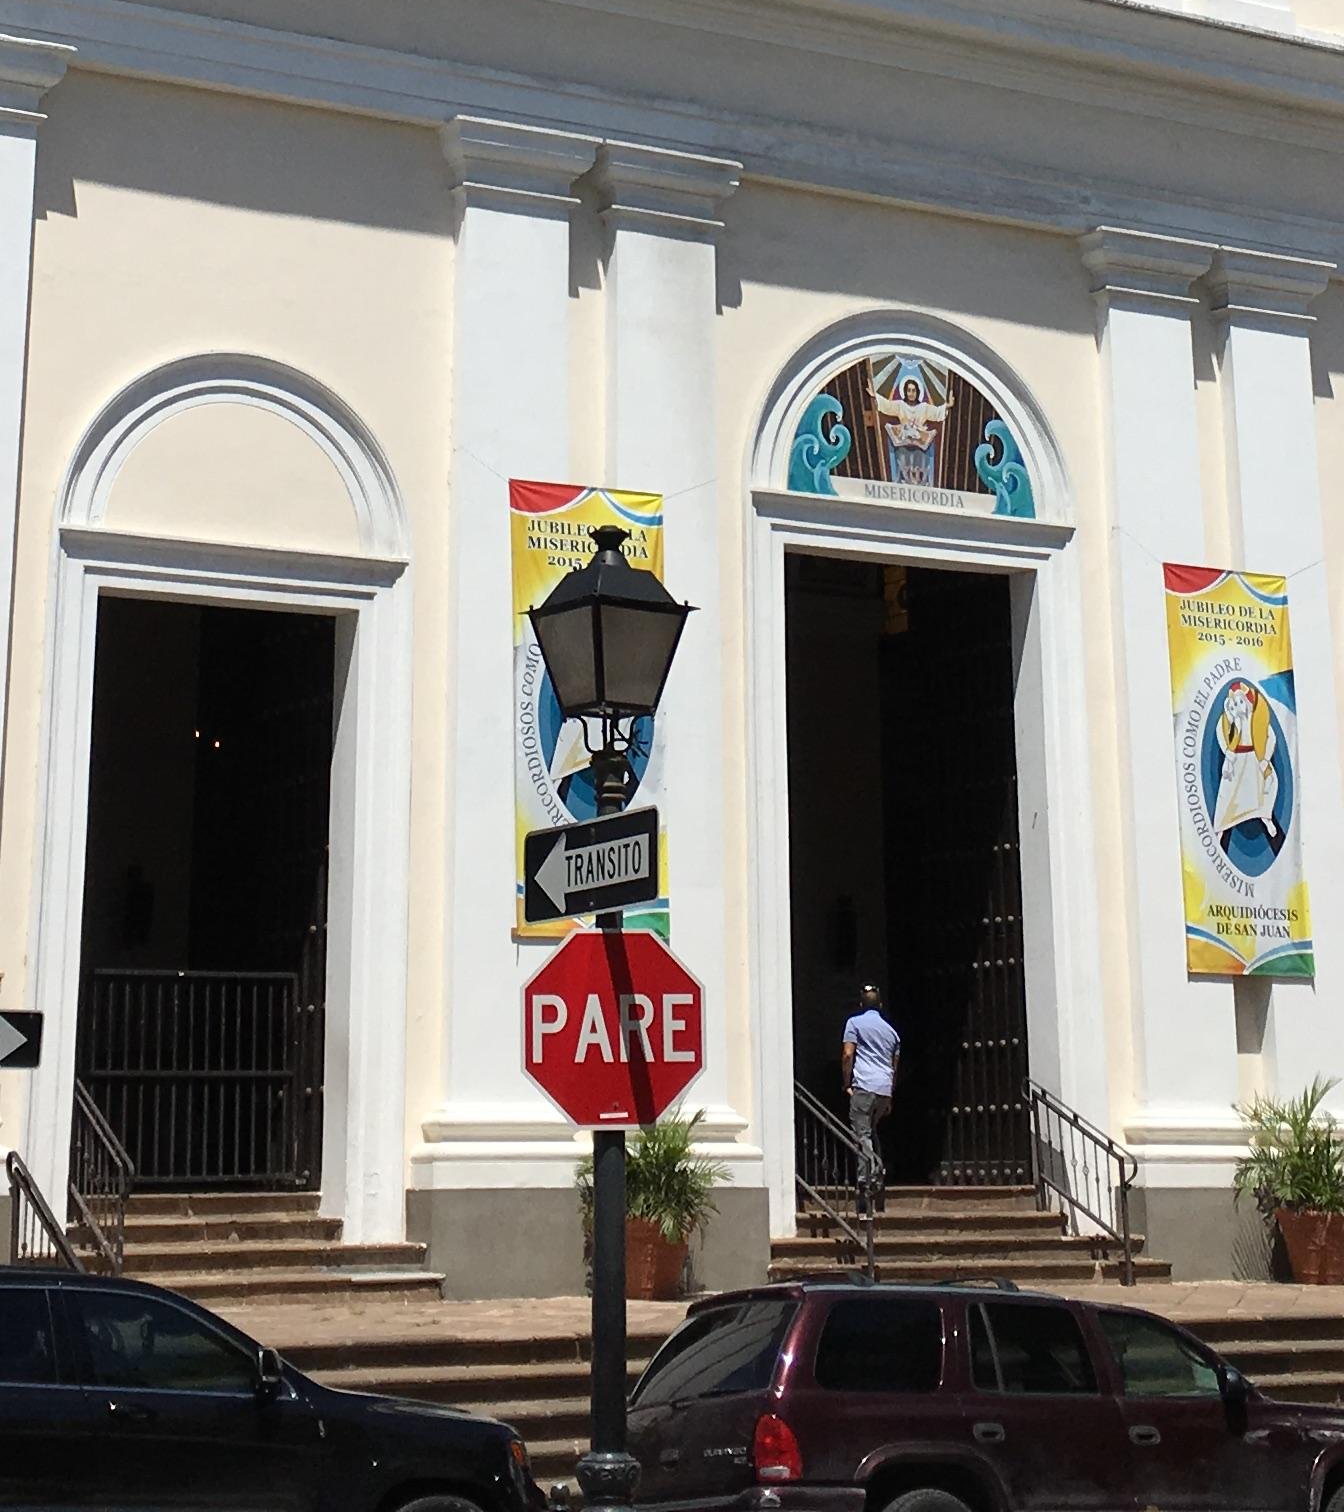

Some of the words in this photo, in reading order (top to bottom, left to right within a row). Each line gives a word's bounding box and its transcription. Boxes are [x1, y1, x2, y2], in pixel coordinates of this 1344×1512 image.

[864, 483, 965, 509] MISERICORDIA
[527, 519, 597, 536] JUBILEO
[527, 535, 649, 559] MISERICDIA
[1180, 599, 1236, 617] JUBILEO
[1239, 606, 1256, 618] DE
[1259, 608, 1275, 620] LA
[1180, 613, 1277, 636] MISERICORDIA
[1197, 632, 1226, 646] 2015
[1235, 635, 1264, 648] 2016
[1203, 656, 1243, 690] PADRE
[1194, 689, 1211, 709] EL
[1183, 709, 1202, 759] COMO
[1183, 761, 1256, 898] MISERICORDIOSOS
[565, 840, 642, 888] TRANSITO
[1207, 903, 1299, 922] ARQUIDIÓCESIS
[1216, 922, 1231, 935] DE
[1234, 923, 1257, 937] SAN
[1259, 926, 1291, 938] JUAN
[532, 993, 696, 1064] PARE
